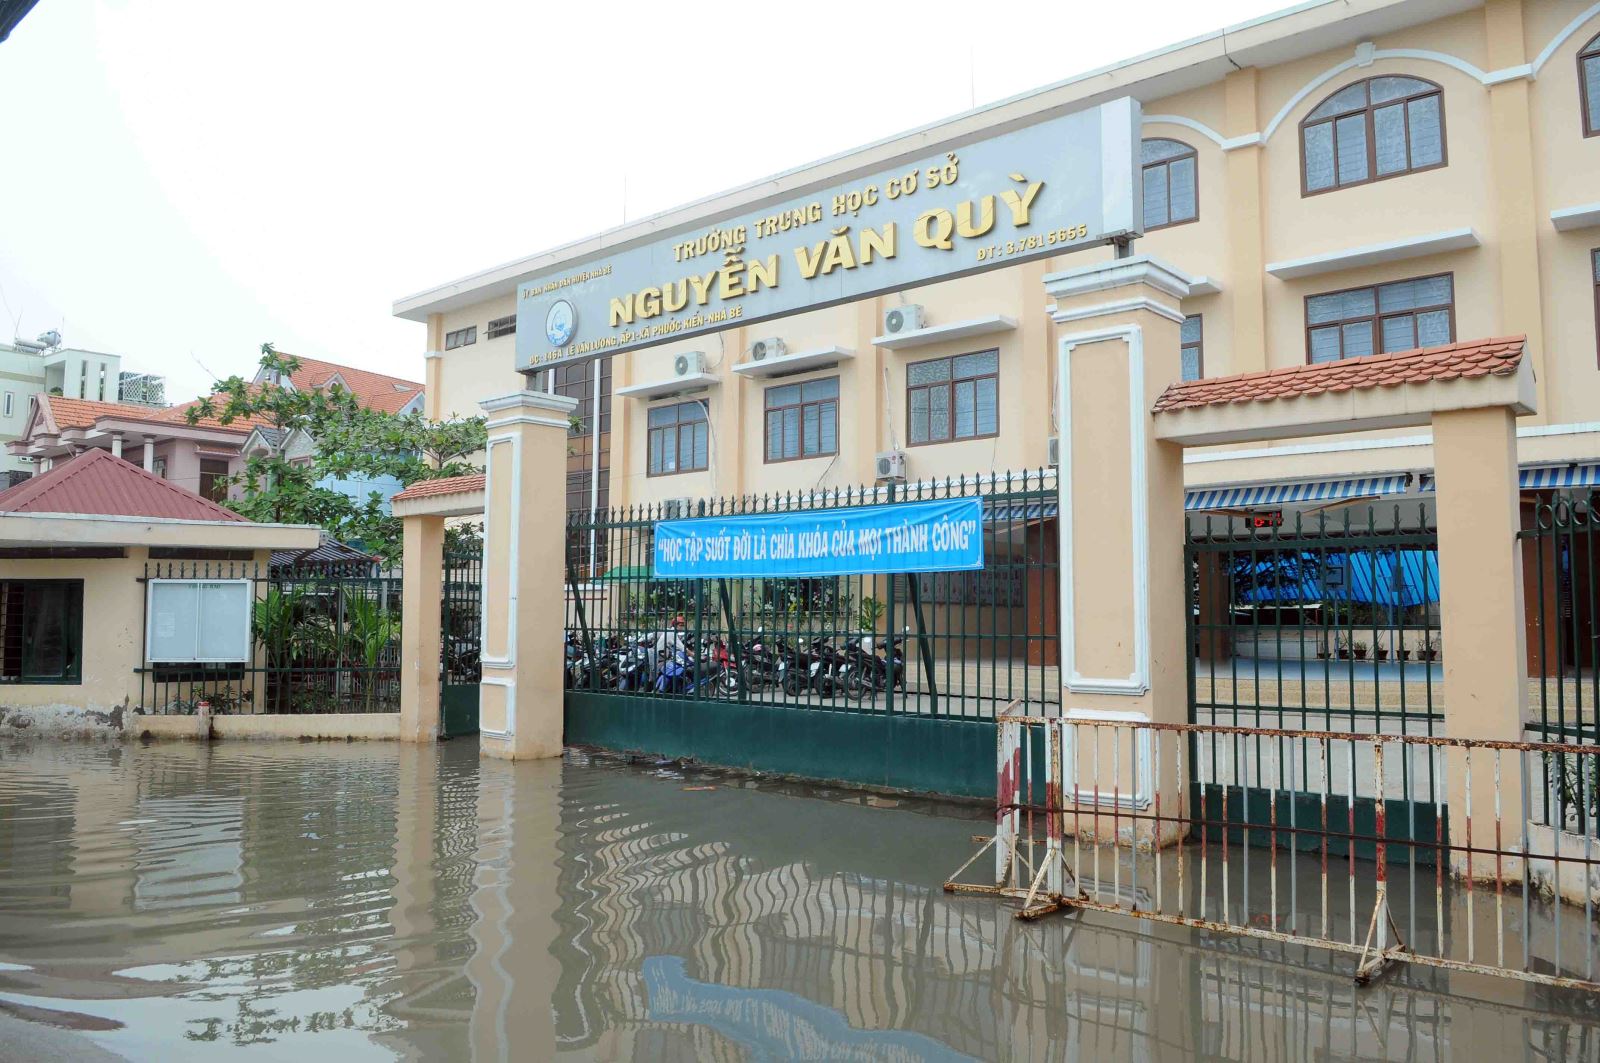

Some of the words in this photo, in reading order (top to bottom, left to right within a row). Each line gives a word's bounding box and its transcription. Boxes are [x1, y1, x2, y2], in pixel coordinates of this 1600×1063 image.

[672, 224, 746, 262] TRƯỜNG
[753, 201, 823, 239] TRUNG
[831, 184, 879, 217] HỌC
[884, 168, 920, 200] CƠ
[925, 151, 960, 188] SỞ
[609, 247, 779, 327] NGUYỄN
[793, 220, 897, 279] VĂN
[913, 172, 1046, 251] QUỲ
[653, 317, 682, 335] PHƯỚC
[685, 531, 704, 566] TẬP
[705, 526, 731, 562] SUỐT
[733, 528, 751, 561] ĐỜI
[753, 527, 767, 560] LÀ
[770, 526, 796, 559] CHÌA
[797, 524, 829, 559] KHÓA
[831, 519, 856, 558] CỦA
[857, 527, 883, 561] MỌI
[885, 518, 929, 555] THÀNH
